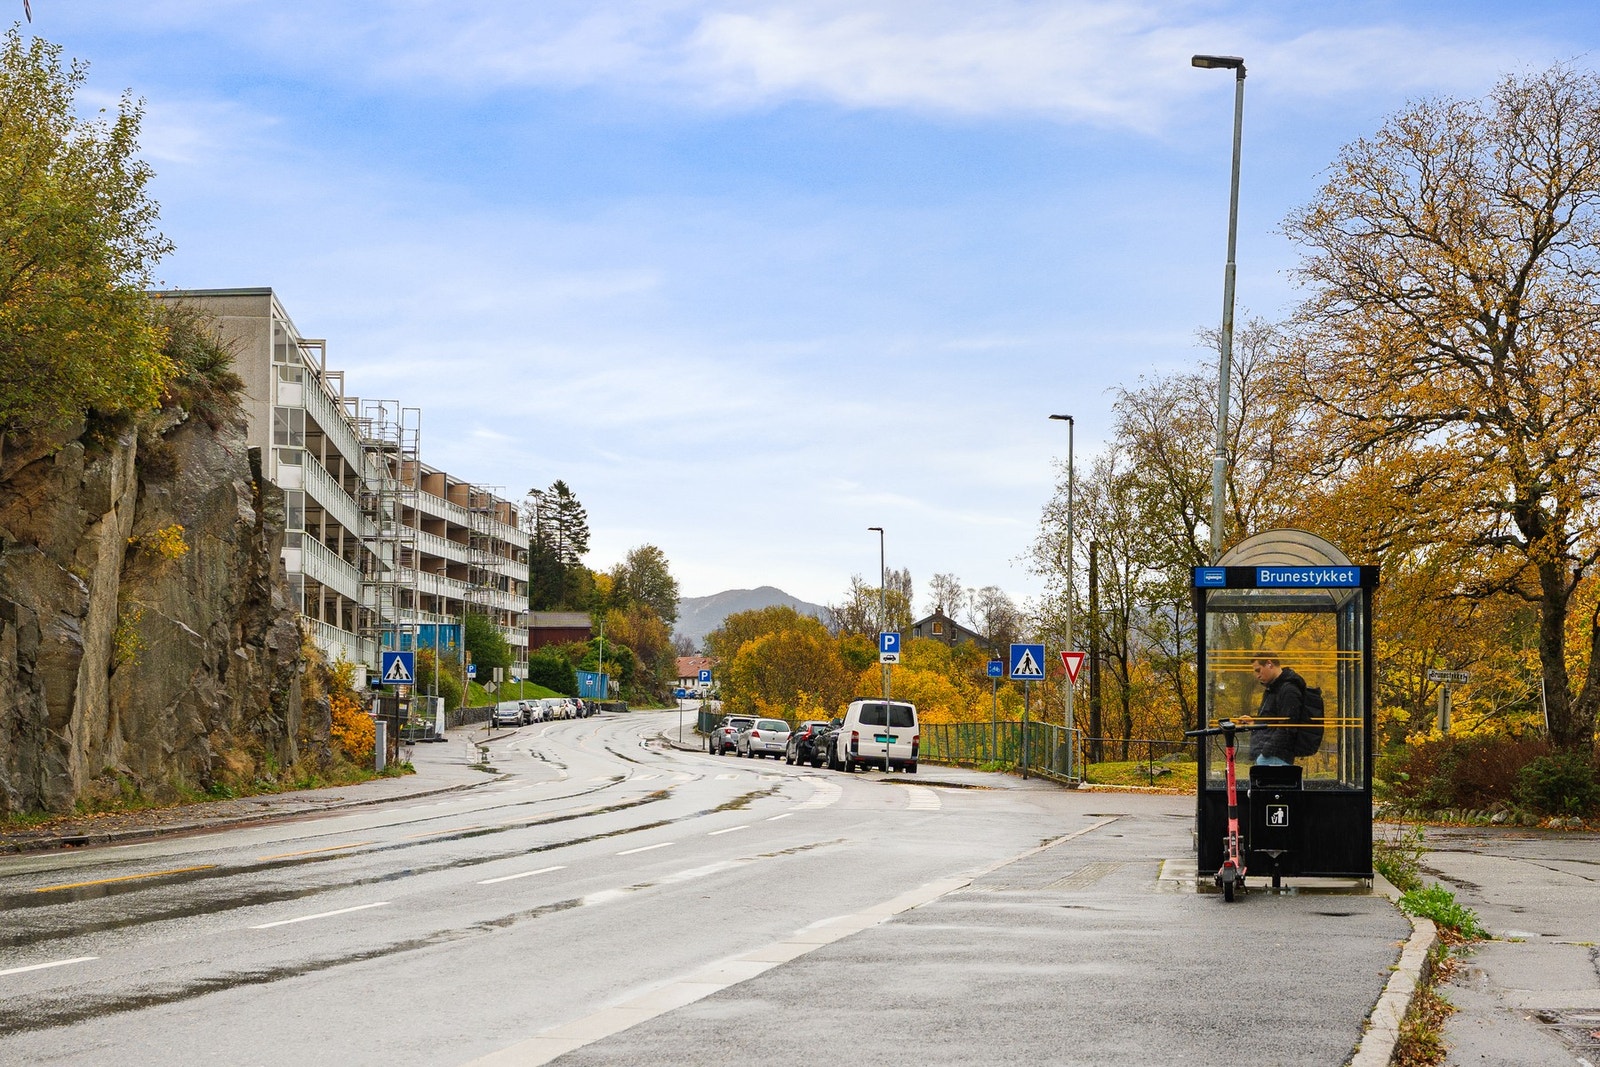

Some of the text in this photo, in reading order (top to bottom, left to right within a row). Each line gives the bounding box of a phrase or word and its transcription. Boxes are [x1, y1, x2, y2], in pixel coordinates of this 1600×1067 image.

[1260, 570, 1353, 585] Brunestykket
[885, 636, 895, 651] P
[702, 671, 708, 680] P
